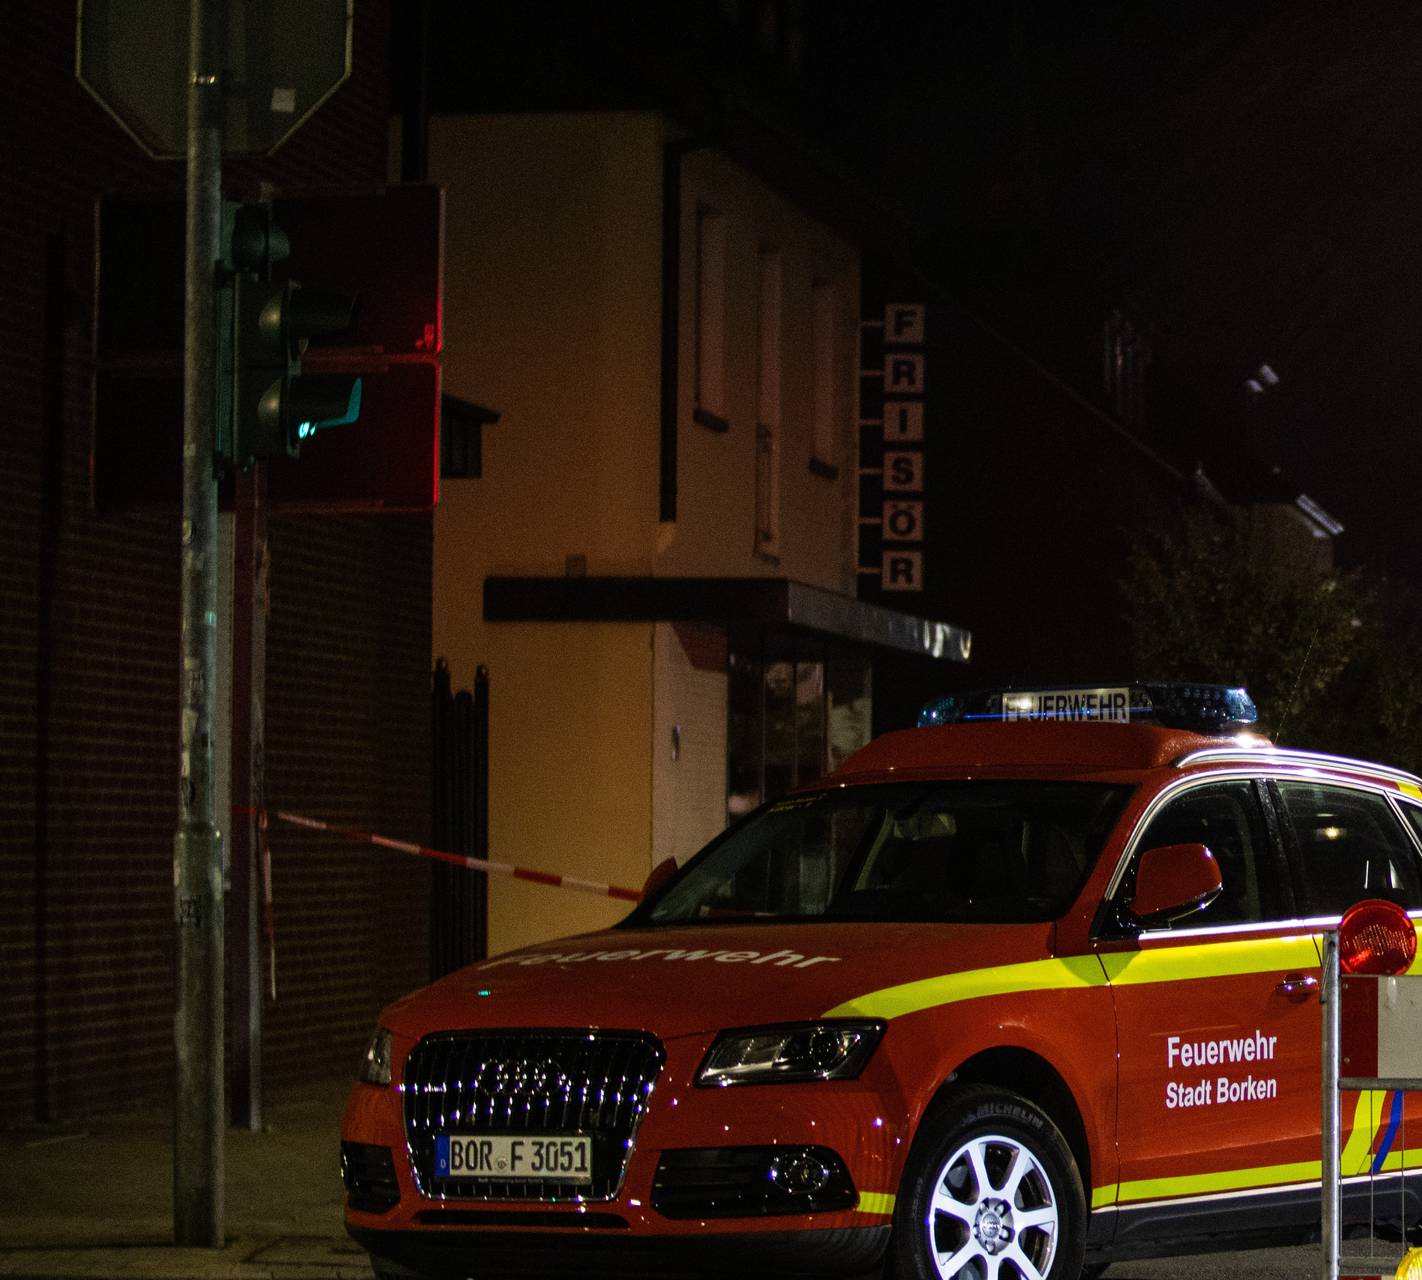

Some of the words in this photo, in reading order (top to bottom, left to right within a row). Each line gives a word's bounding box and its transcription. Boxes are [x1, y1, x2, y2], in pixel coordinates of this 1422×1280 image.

[888, 309, 918, 586] FRISÖR
[477, 949, 842, 970] Feuerwehr
[1167, 1029, 1277, 1068] Feuerwehr
[1166, 1079, 1212, 1109] Stadt
[1216, 1075, 1277, 1104] Borken
[451, 1139, 492, 1171] BOR
[510, 1141, 524, 1171] F
[531, 1140, 588, 1172] 3051
